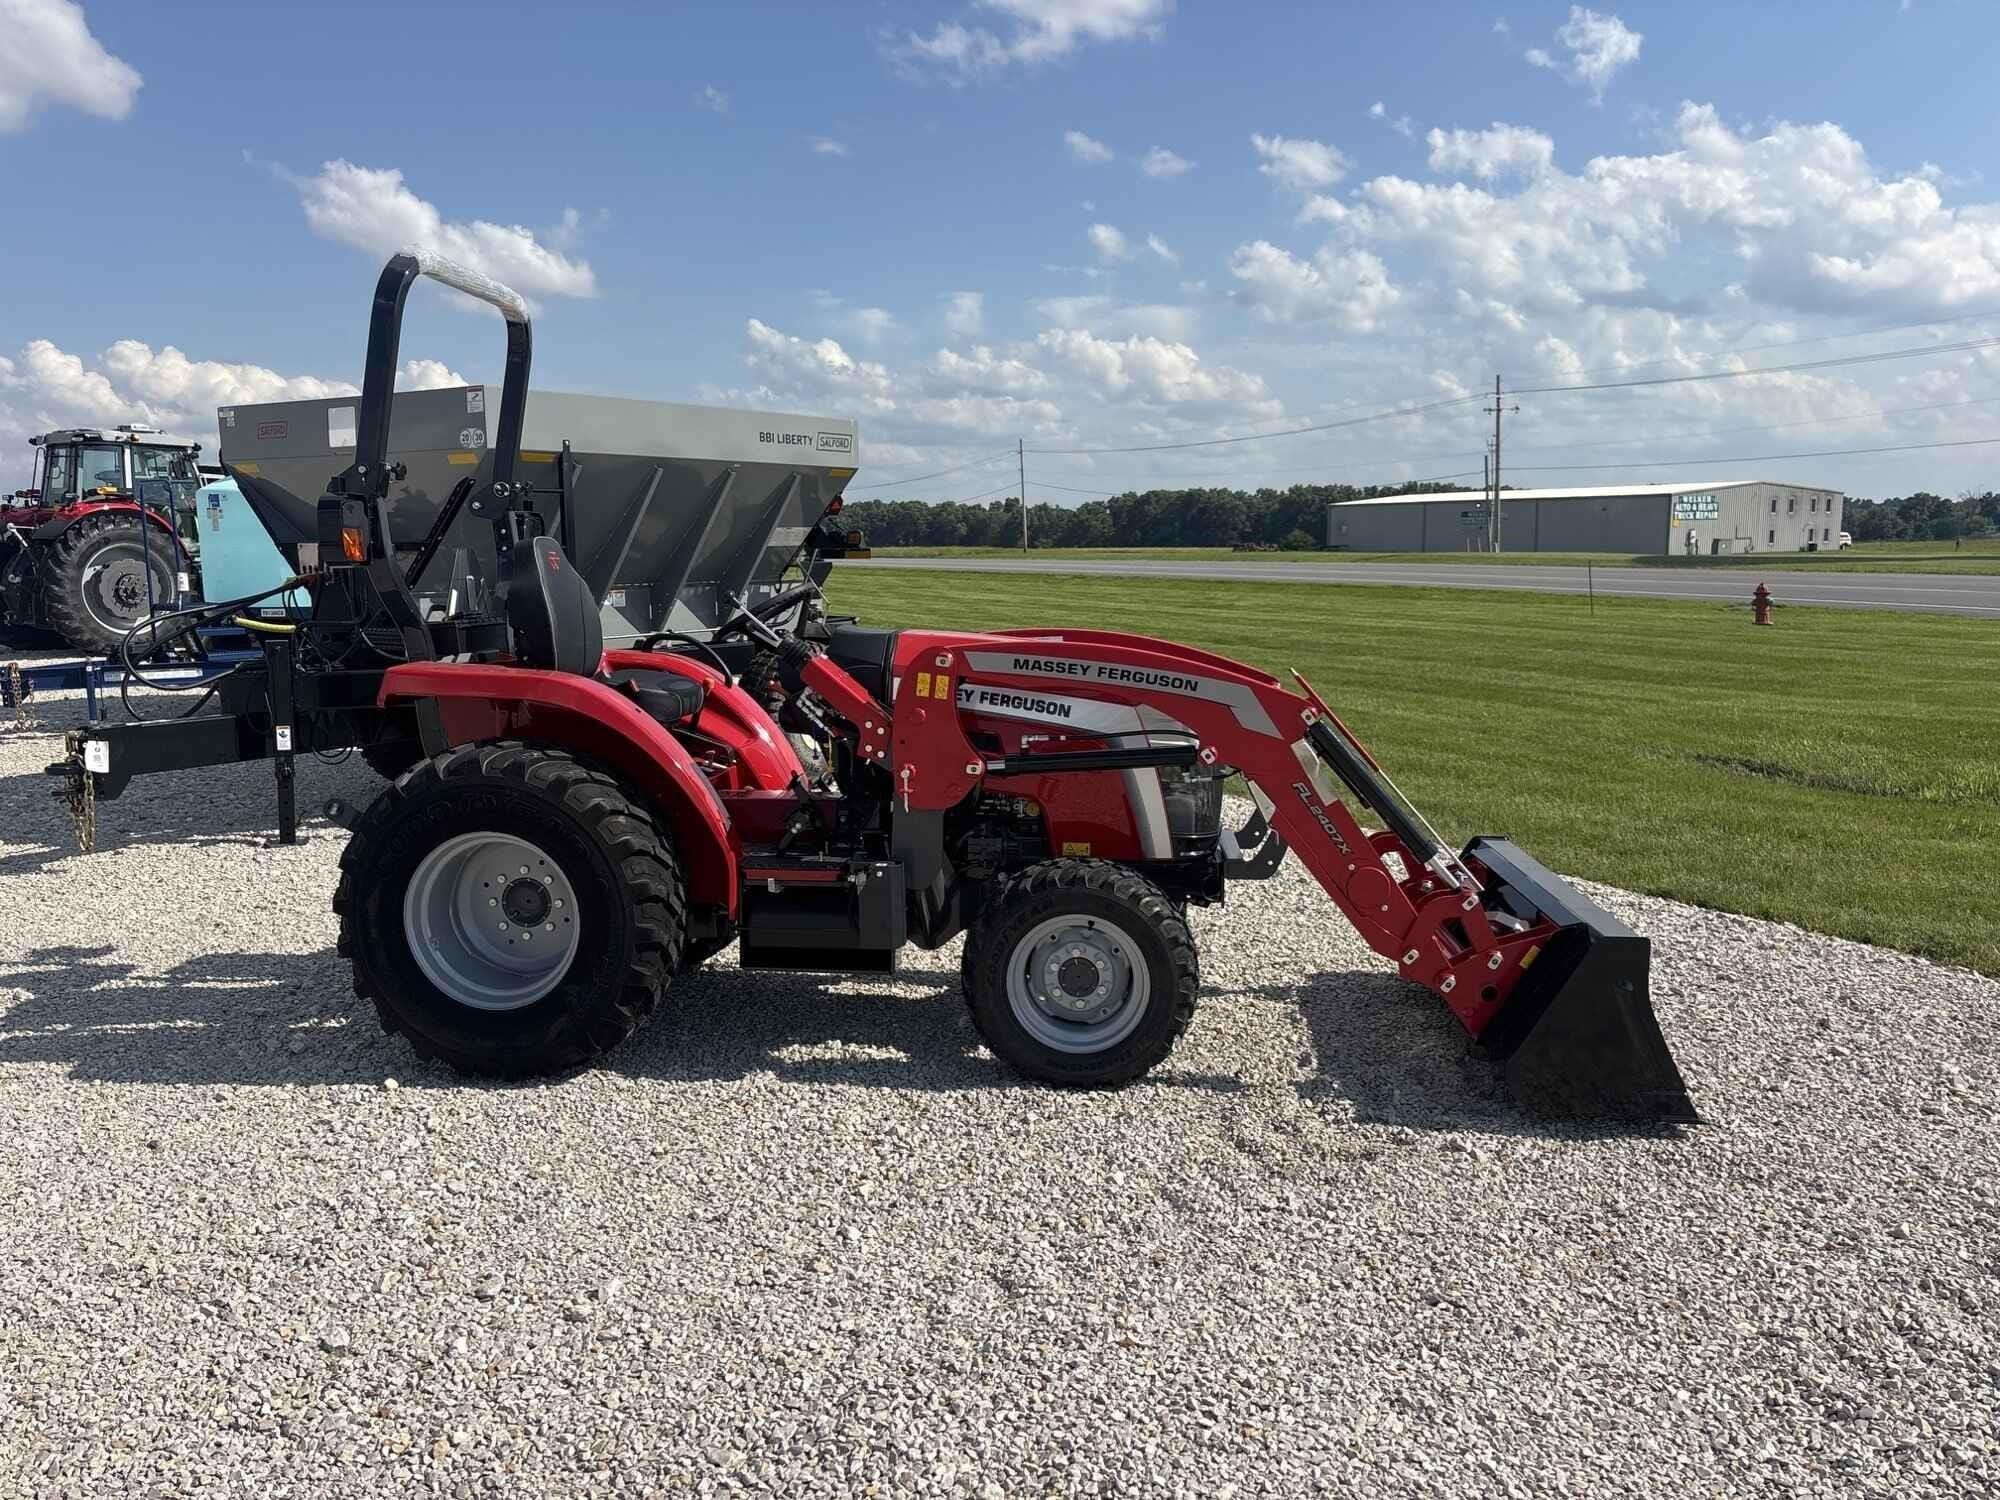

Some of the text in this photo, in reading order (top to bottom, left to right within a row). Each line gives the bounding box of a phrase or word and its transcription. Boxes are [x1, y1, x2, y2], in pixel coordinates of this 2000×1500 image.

[760, 432, 813, 446] BBI LIBERTY
[820, 437, 850, 449] SALFORD
[1013, 658, 1199, 692] MASSEY FERGUSON
[979, 691, 1072, 718] FERGUSON
